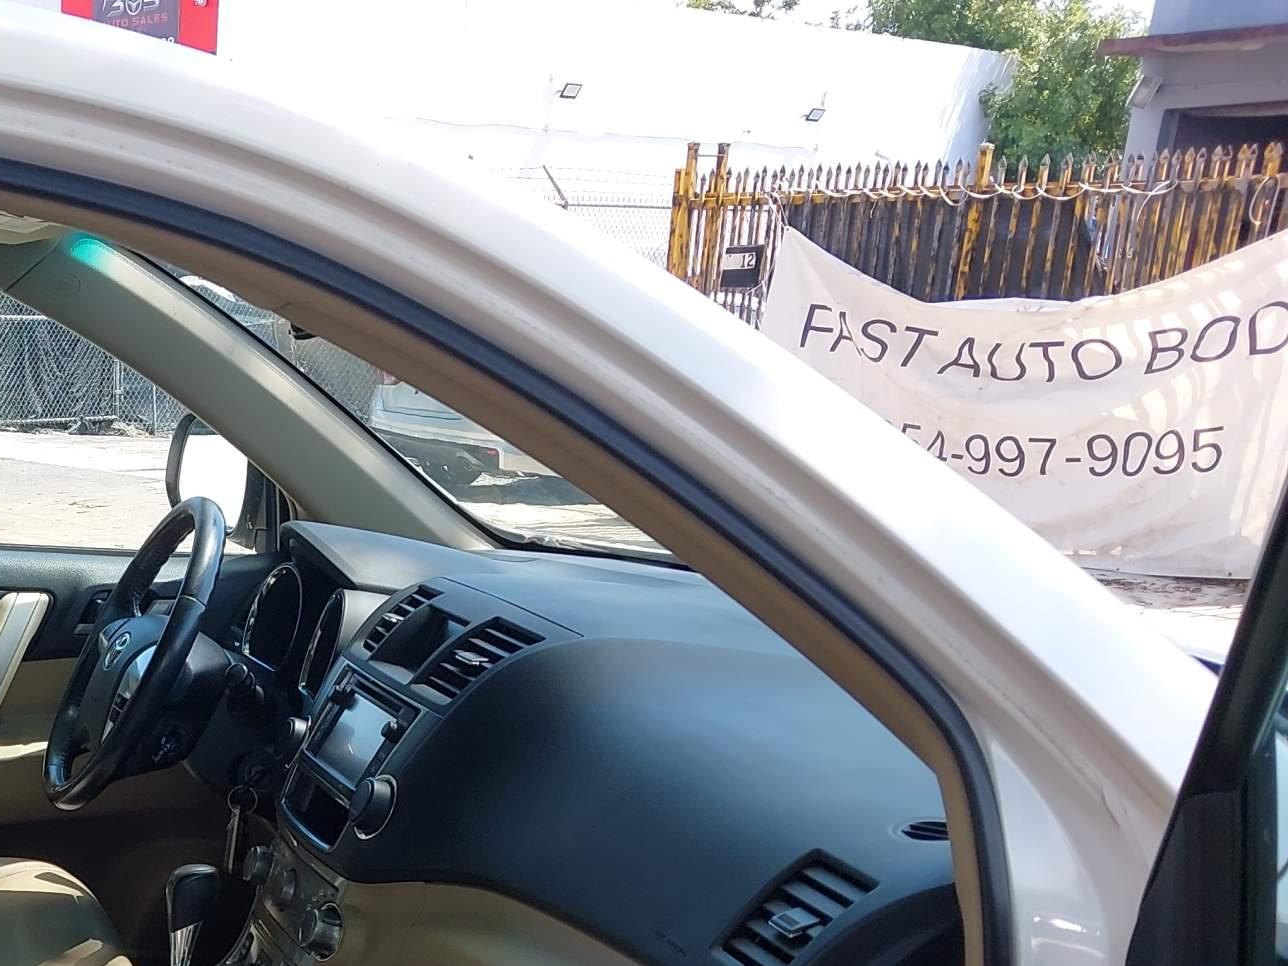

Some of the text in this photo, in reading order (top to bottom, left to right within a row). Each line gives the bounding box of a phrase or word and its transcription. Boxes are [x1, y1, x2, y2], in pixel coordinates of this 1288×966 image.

[131, 12, 169, 26] SALES
[799, 303, 939, 368] FAST
[937, 336, 1123, 383] AUTO
